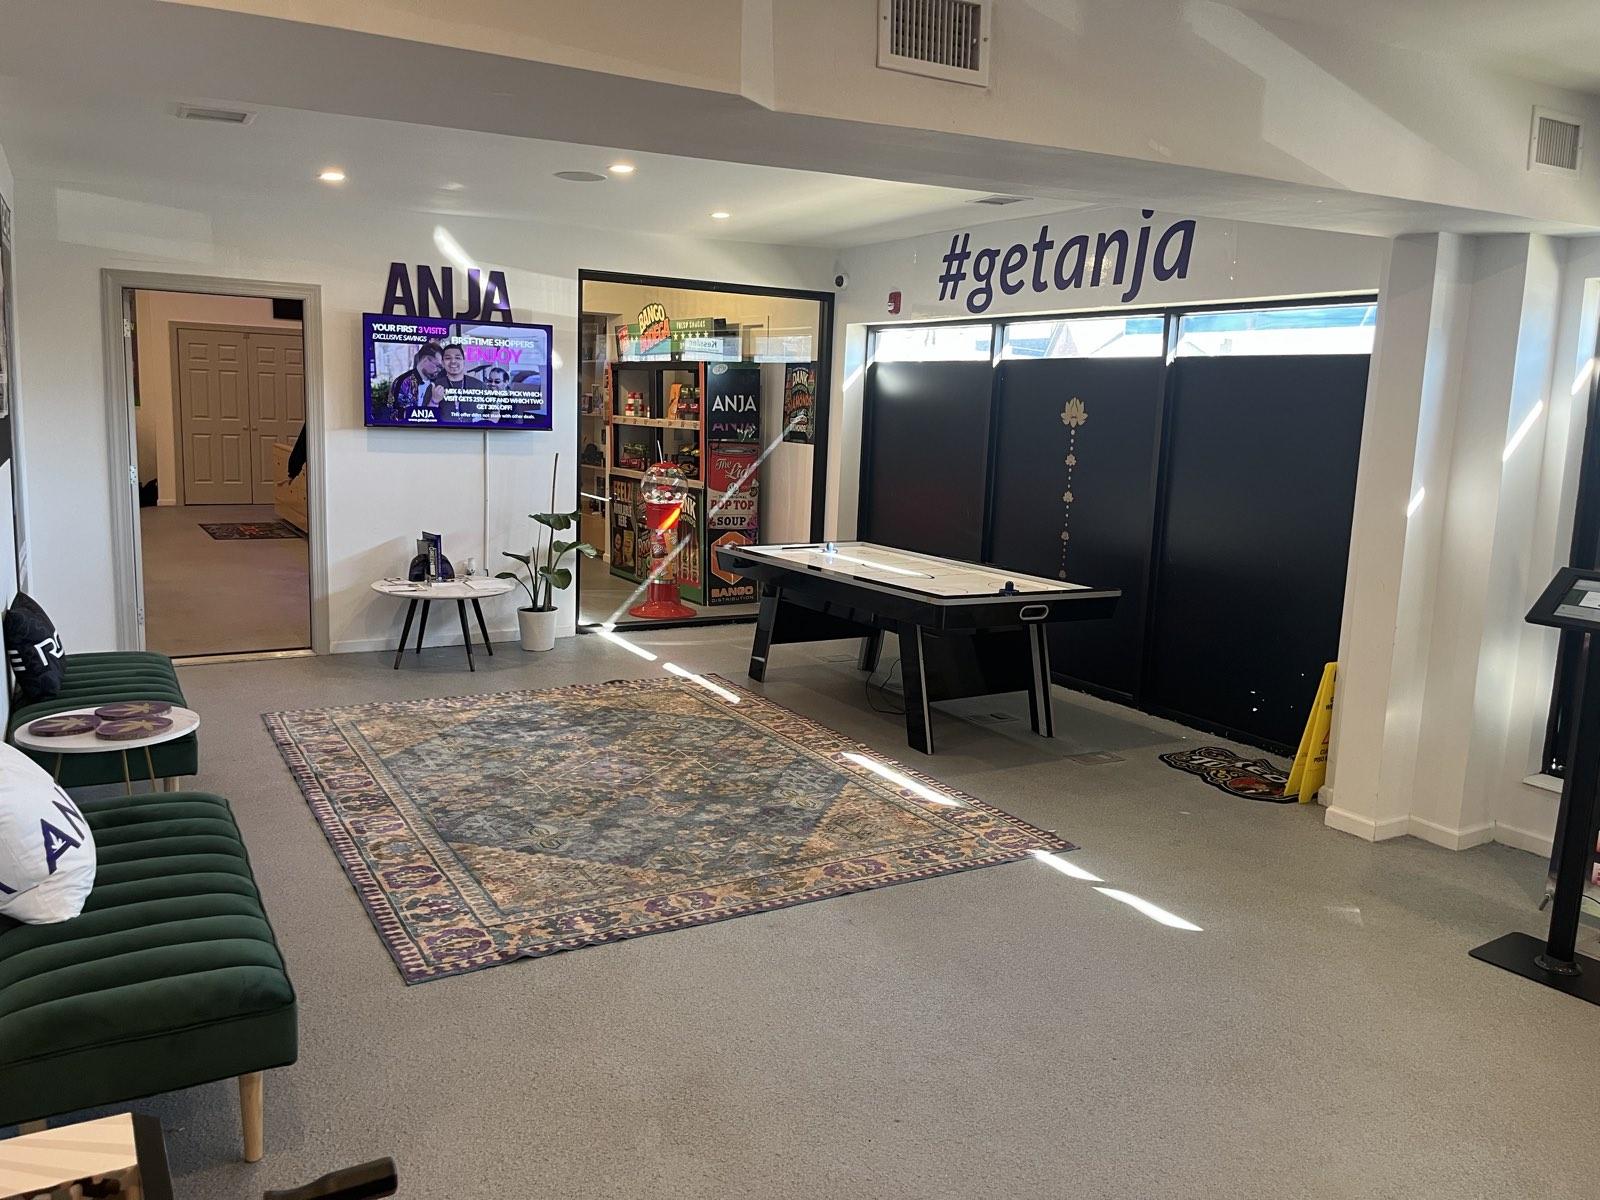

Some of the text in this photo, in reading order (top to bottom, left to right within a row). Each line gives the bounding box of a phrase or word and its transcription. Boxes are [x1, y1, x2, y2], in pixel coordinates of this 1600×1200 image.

[939, 209, 1196, 313] #getanja
[382, 262, 513, 323] ANJA
[372, 323, 395, 332] YOUR
[396, 325, 418, 333] FIRST
[424, 327, 447, 335] VISITS
[372, 333, 402, 341] EXCLUSIVE
[495, 339, 534, 348] SHOPPERS
[466, 345, 522, 364] ENJOY
[712, 394, 757, 412] ANJA
[411, 409, 435, 418] ANJA
[715, 458, 731, 469] The
[711, 499, 754, 510] POP TOP
[717, 516, 746, 526] SOUP
[711, 585, 754, 598] BANGO
